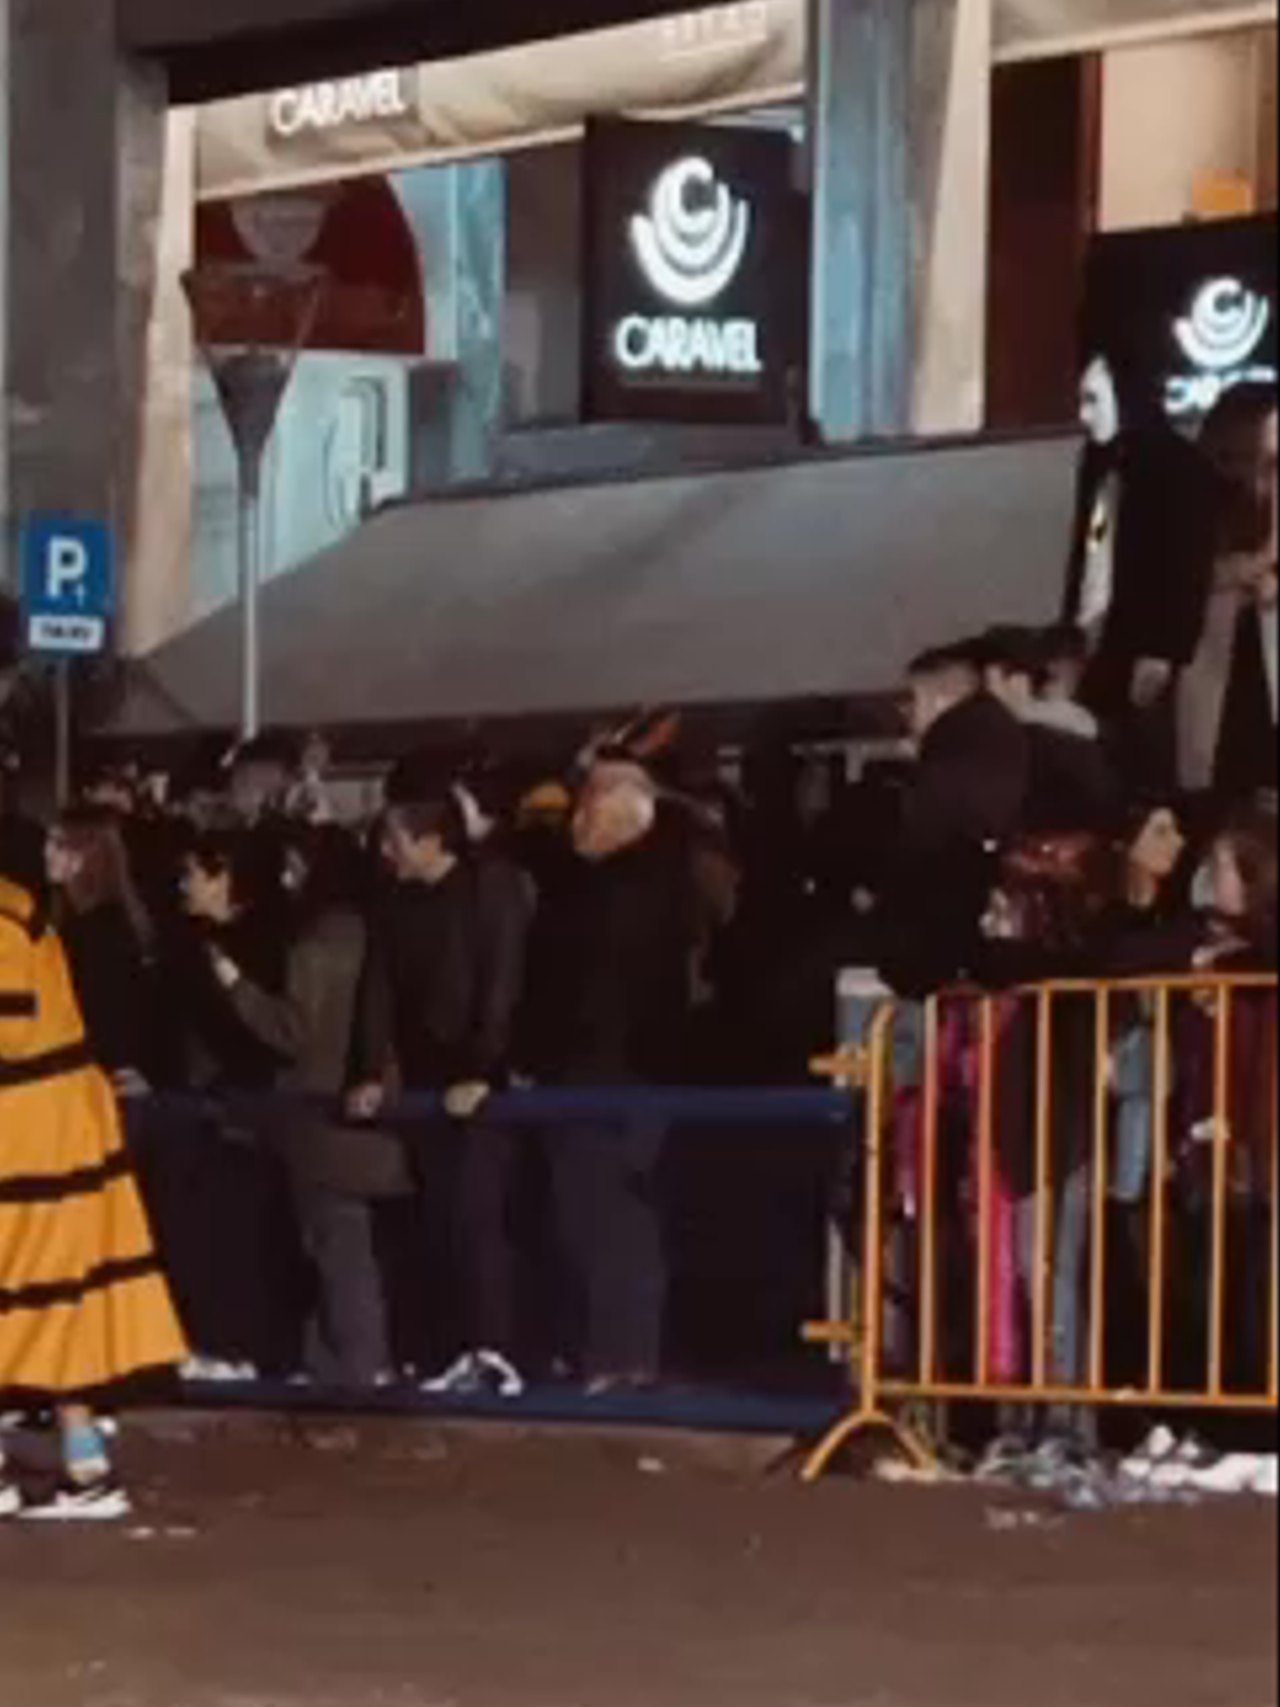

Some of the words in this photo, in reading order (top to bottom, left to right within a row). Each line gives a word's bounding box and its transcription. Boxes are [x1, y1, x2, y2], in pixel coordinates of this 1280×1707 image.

[269, 68, 406, 136] CARAVEL
[615, 314, 763, 372] CARAVEL
[48, 534, 89, 599] P
